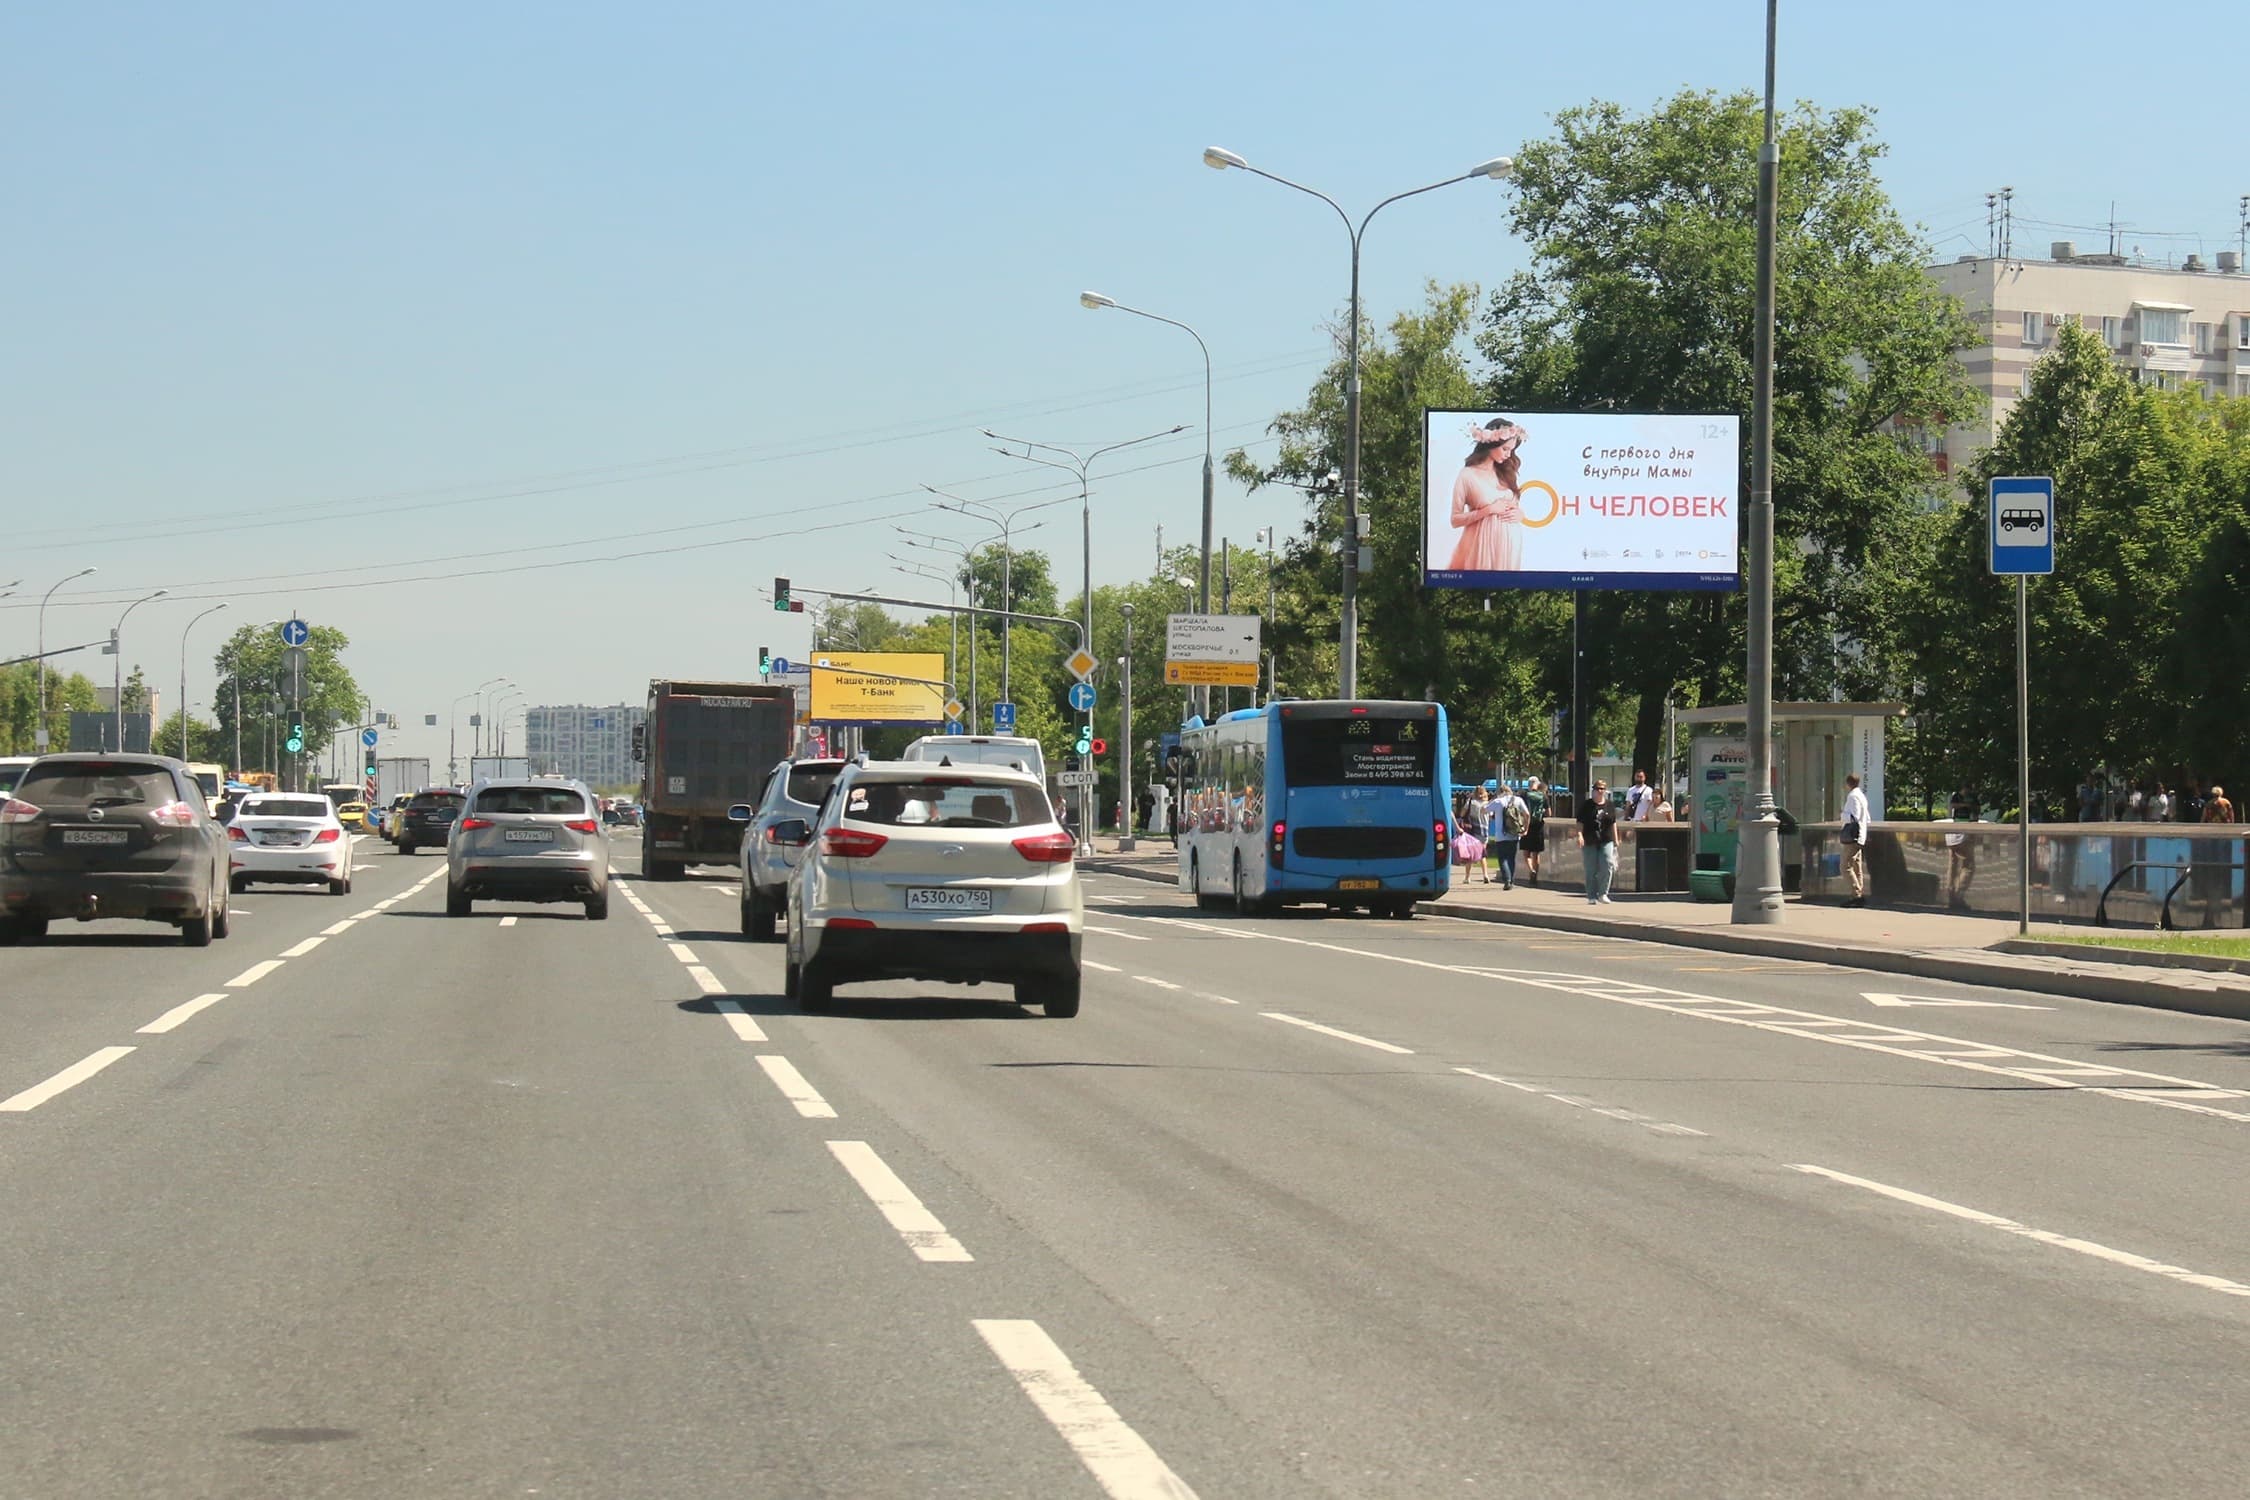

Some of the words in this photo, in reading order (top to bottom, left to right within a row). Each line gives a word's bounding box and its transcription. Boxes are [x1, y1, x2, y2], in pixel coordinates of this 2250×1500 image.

[1700, 424, 1728, 439] 12+
[1582, 446, 1592, 459] С
[1601, 446, 1661, 461] первого
[1669, 446, 1695, 460] дня
[1583, 463, 1640, 479] внутри
[1647, 465, 1692, 479] Мамы
[1519, 480, 1580, 528] ОН
[1590, 496, 1728, 518] ЧЕЛОВЕК
[836, 676, 864, 685] Наше
[866, 678, 897, 686] новое
[861, 688, 895, 696] Т-Банк
[294, 725, 302, 738] 5
[1083, 725, 1090, 739] 5
[1063, 774, 1092, 784] СТОП
